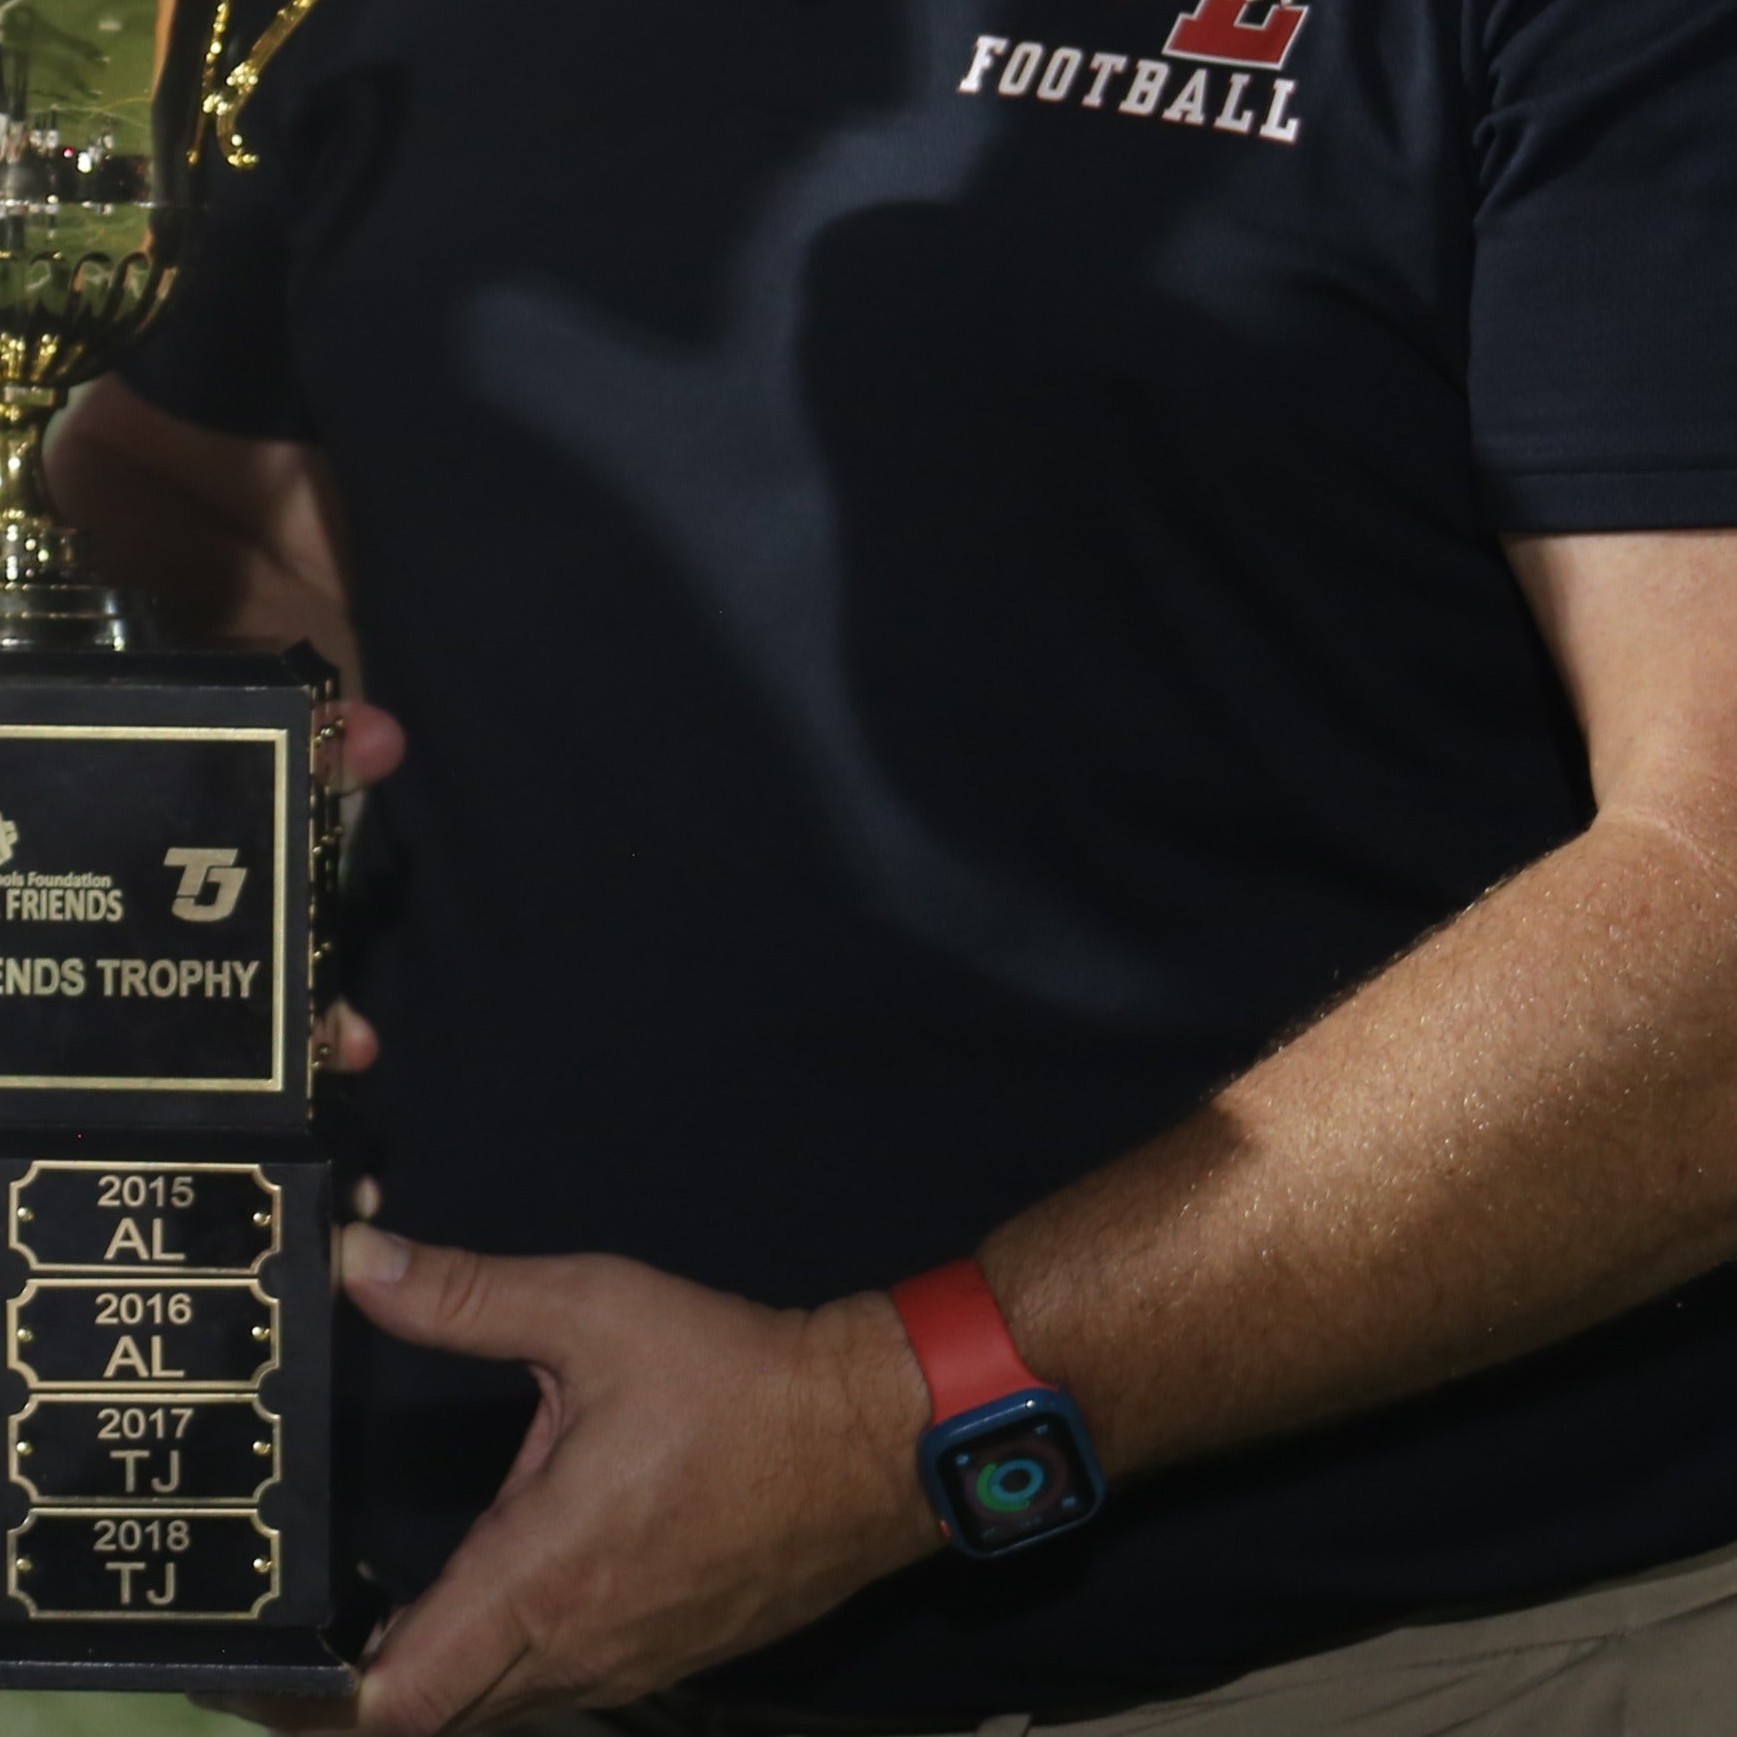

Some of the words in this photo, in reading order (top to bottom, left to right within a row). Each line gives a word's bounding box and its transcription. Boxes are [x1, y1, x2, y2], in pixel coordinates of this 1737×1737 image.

[959, 34, 1300, 143] FOOTBALL
[27, 872, 111, 888] Foundation
[5, 889, 123, 922] FRIENDS
[96, 960, 259, 998] TROPHY
[97, 1175, 195, 1209] 2015
[104, 1218, 185, 1262] AL
[95, 1294, 192, 1326] 2016
[103, 1335, 185, 1379] AL
[97, 1409, 195, 1441] 2017
[110, 1450, 181, 1494] TJ
[93, 1520, 190, 1552] 2018
[106, 1563, 176, 1606] TJ
